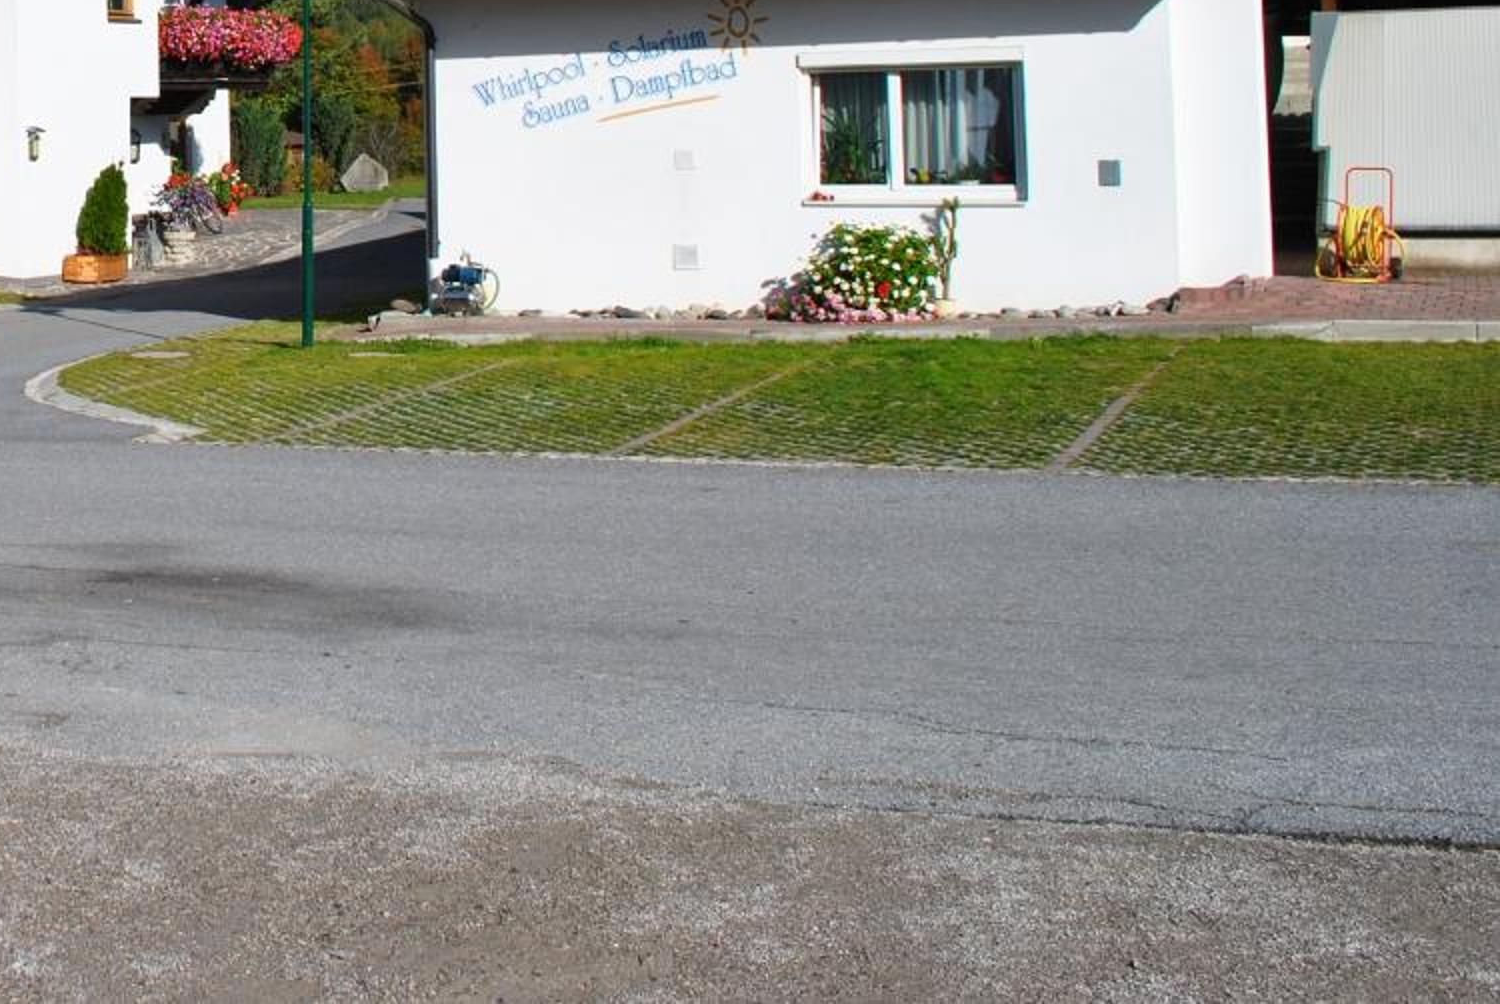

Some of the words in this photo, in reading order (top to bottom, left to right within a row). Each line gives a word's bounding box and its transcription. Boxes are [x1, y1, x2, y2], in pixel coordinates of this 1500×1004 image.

[472, 52, 586, 107] Whirlpool
[607, 28, 708, 67] Solarium
[522, 95, 590, 128] Sauna
[611, 52, 738, 102] Dampfbad
